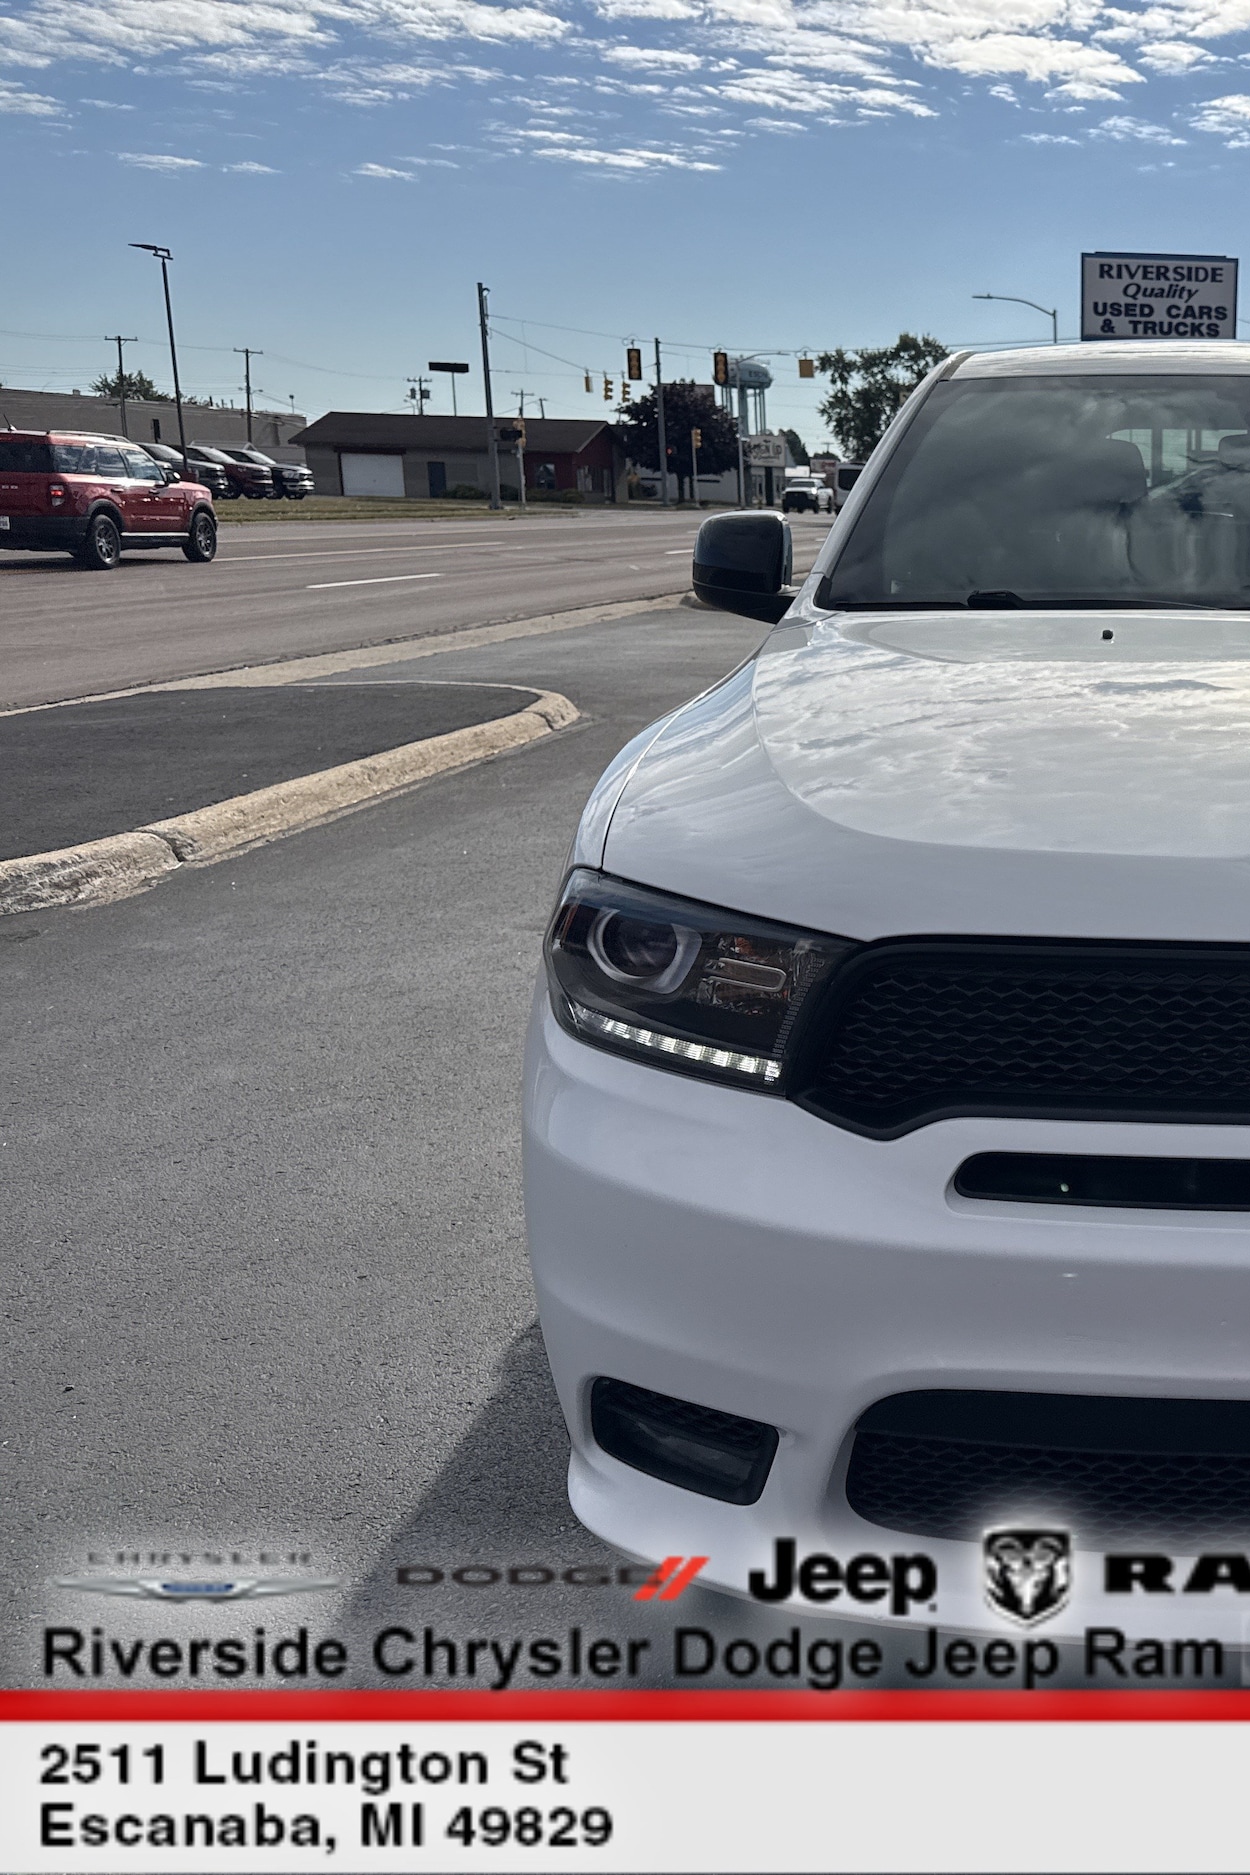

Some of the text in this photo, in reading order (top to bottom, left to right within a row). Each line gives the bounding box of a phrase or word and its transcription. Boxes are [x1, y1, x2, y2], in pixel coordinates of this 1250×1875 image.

[1098, 263, 1224, 283] RIVERSIDE
[1122, 282, 1199, 303] Quality
[1093, 301, 1228, 321] USED CARS
[1100, 318, 1220, 338] & TRUCKS
